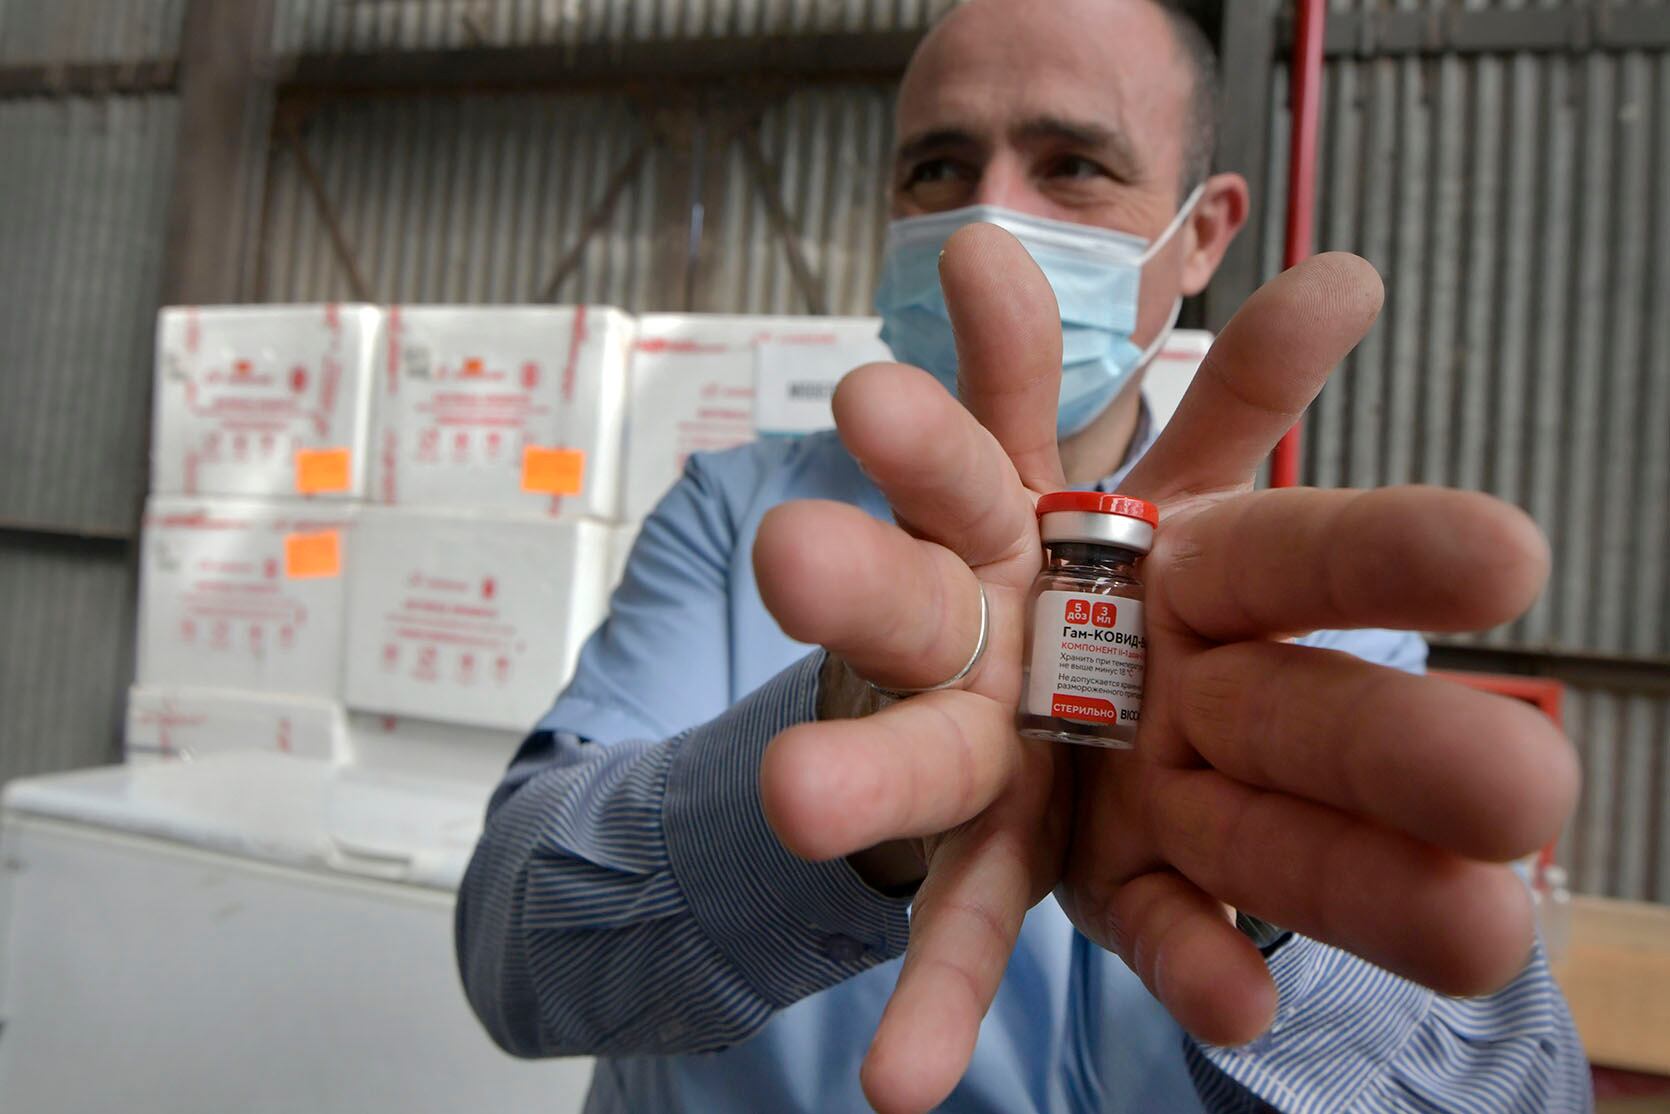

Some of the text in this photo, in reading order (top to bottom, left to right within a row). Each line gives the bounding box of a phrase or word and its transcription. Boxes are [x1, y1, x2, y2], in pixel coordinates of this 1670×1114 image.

[1074, 603, 1082, 612] 5
[1101, 606, 1108, 616] 3
[1061, 642, 1117, 655] КОМПОНЕНТ
[1060, 652, 1094, 663] Хранить
[1095, 666, 1118, 676] минус
[1058, 673, 1069, 681] Не
[1070, 675, 1119, 687] допускается
[1057, 682, 1123, 697] размороженного
[1053, 703, 1115, 719] СТЕРИЛЬНО
